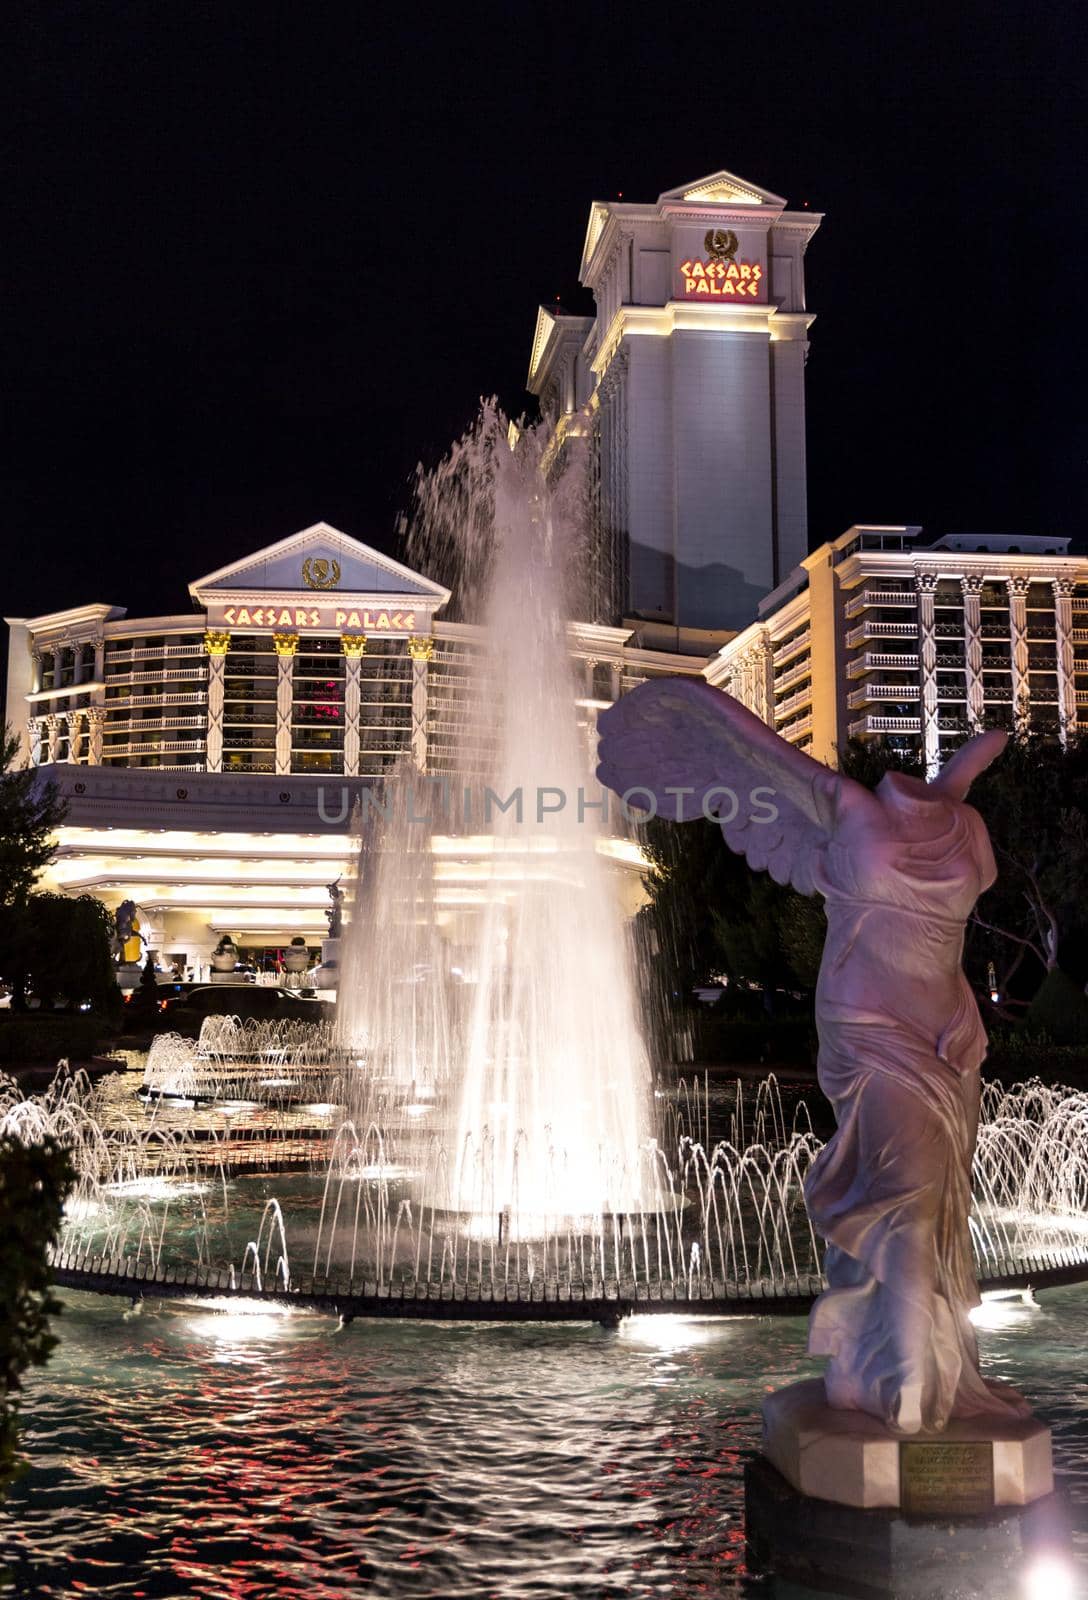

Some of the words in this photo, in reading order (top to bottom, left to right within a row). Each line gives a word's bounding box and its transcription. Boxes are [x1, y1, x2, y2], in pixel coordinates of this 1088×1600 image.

[680, 261, 762, 281] CAESARS
[685, 278, 758, 296] PALACE
[223, 607, 321, 626] CAESARS
[335, 609, 416, 630] PALACE
